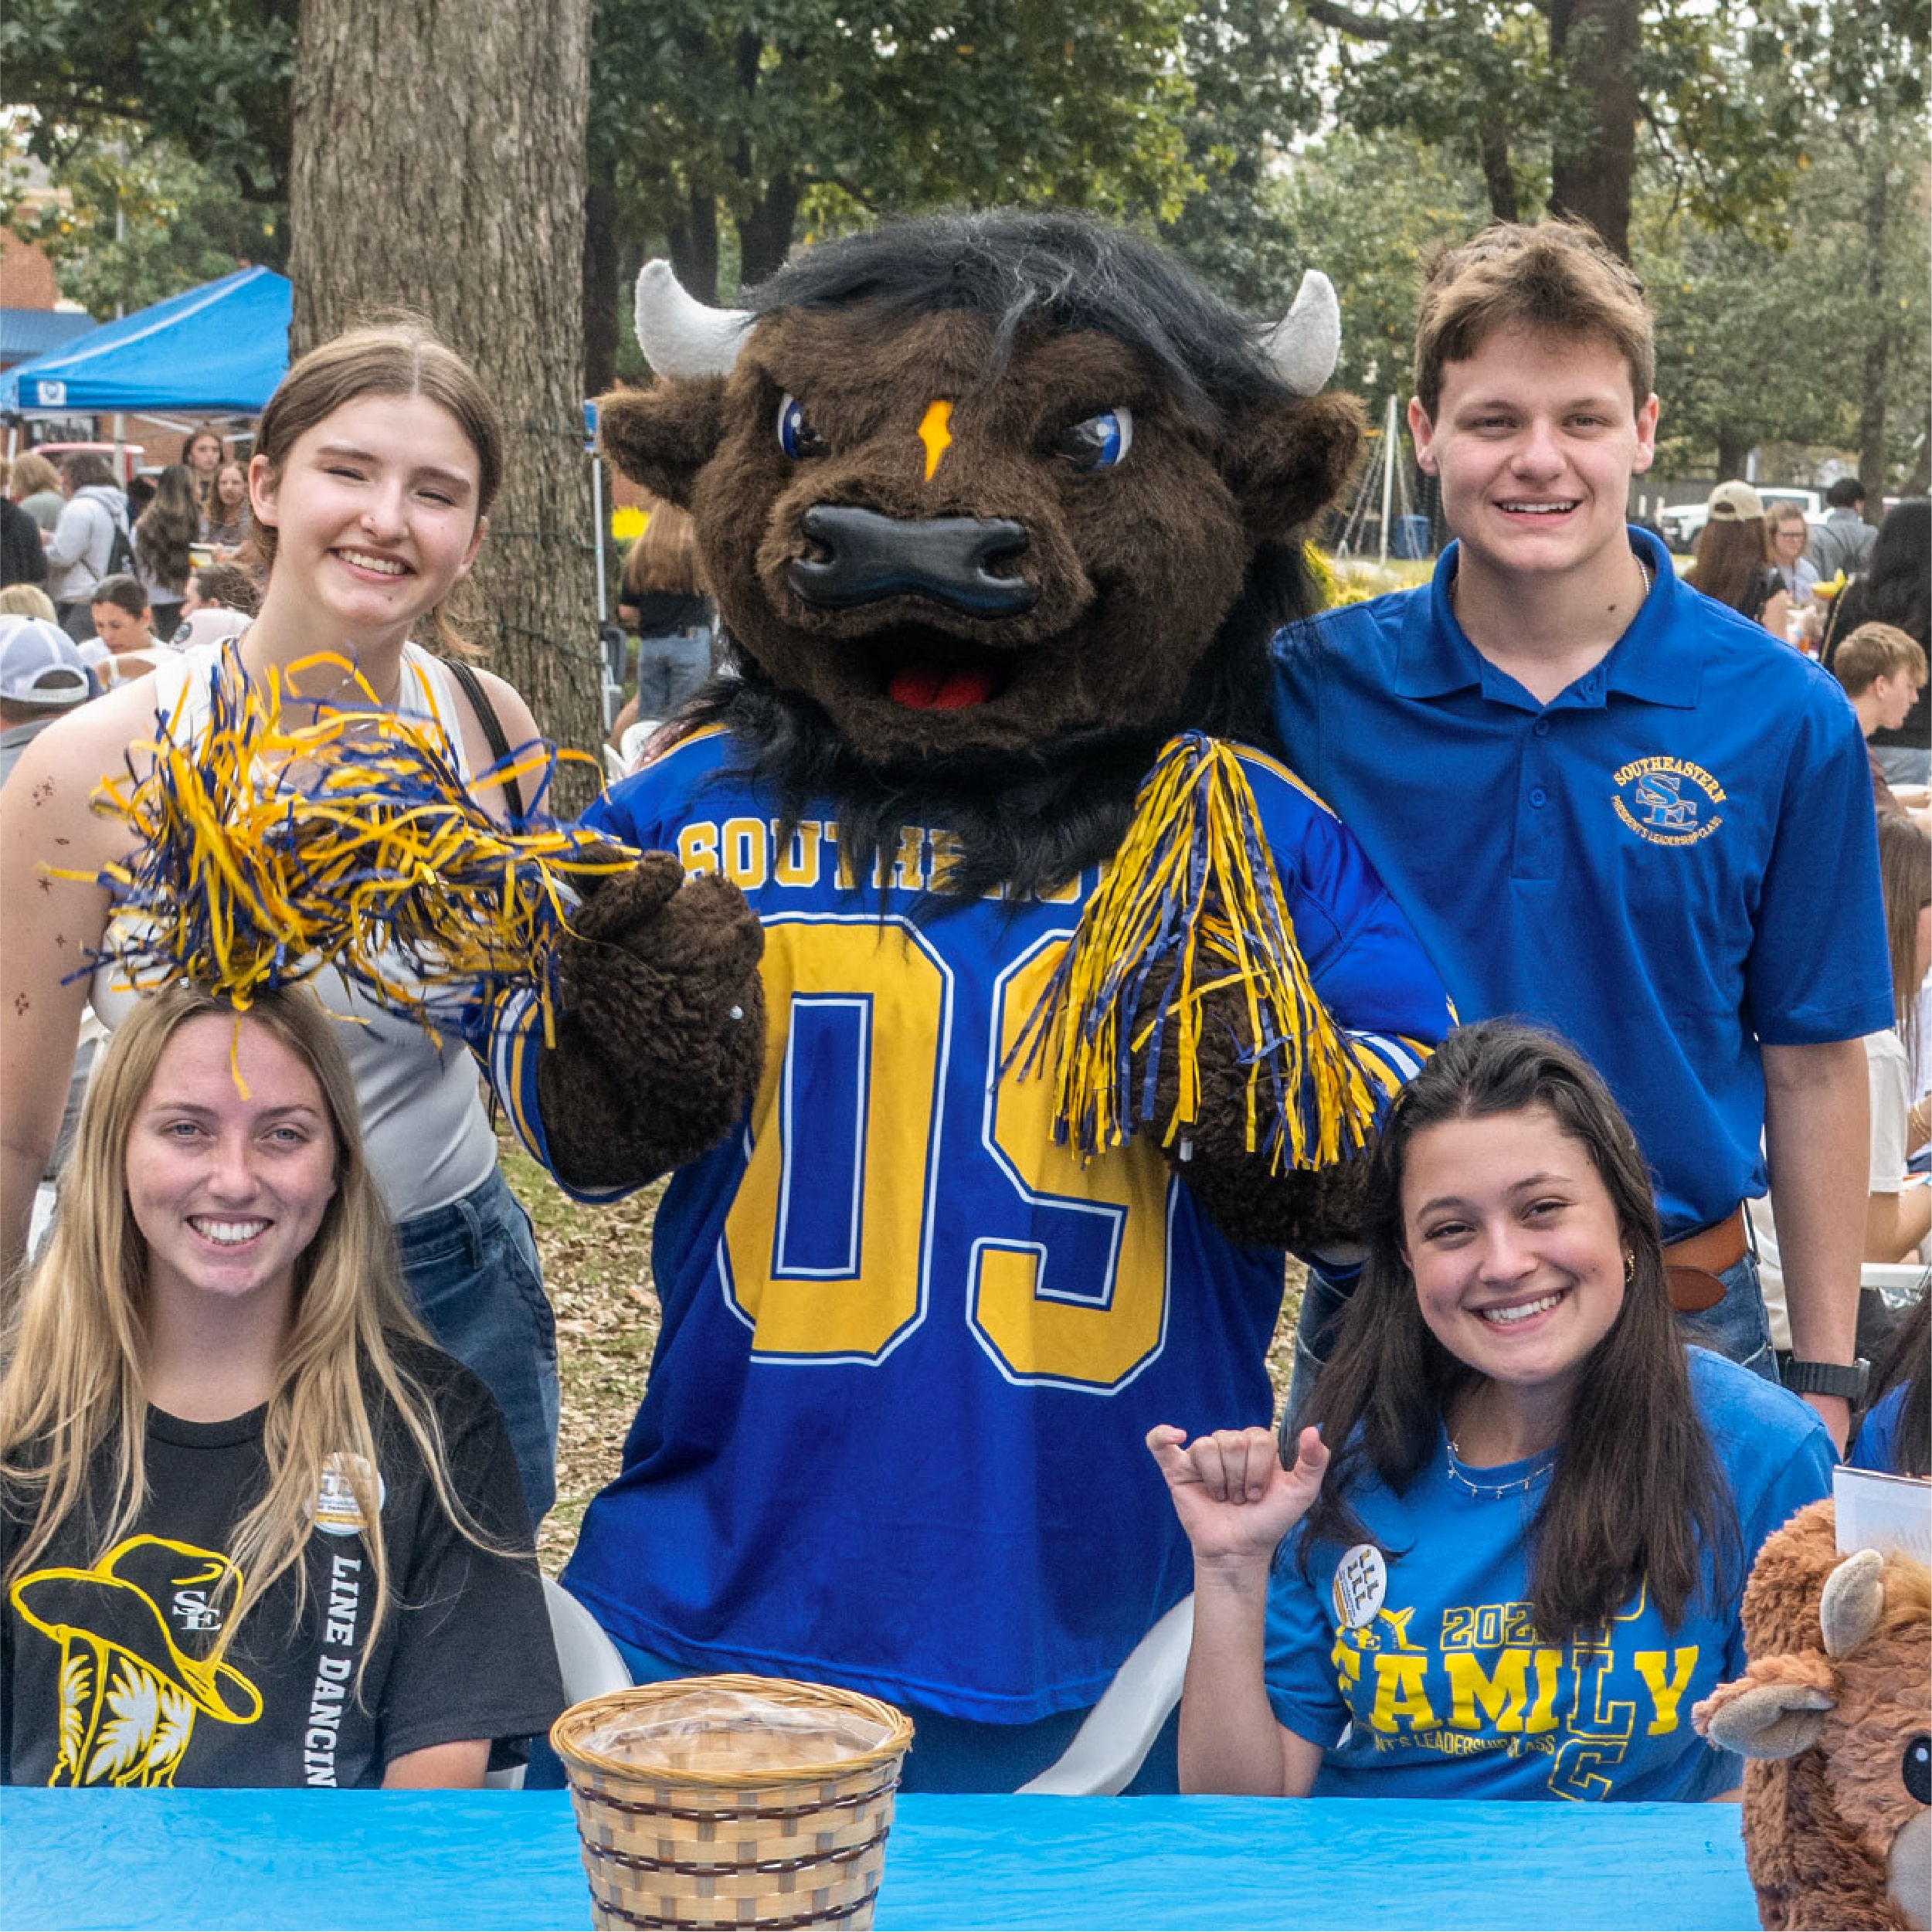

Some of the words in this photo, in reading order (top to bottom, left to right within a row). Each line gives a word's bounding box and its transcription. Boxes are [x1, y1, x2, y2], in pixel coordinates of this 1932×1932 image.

[1613, 756, 1727, 804] SOUTHEASTERN
[1636, 773, 1699, 831] SE
[715, 912, 1180, 1396] 09
[324, 1553, 362, 1646] LINE
[1440, 1601, 1547, 1651] 202
[303, 1654, 351, 1788] DANCIN
